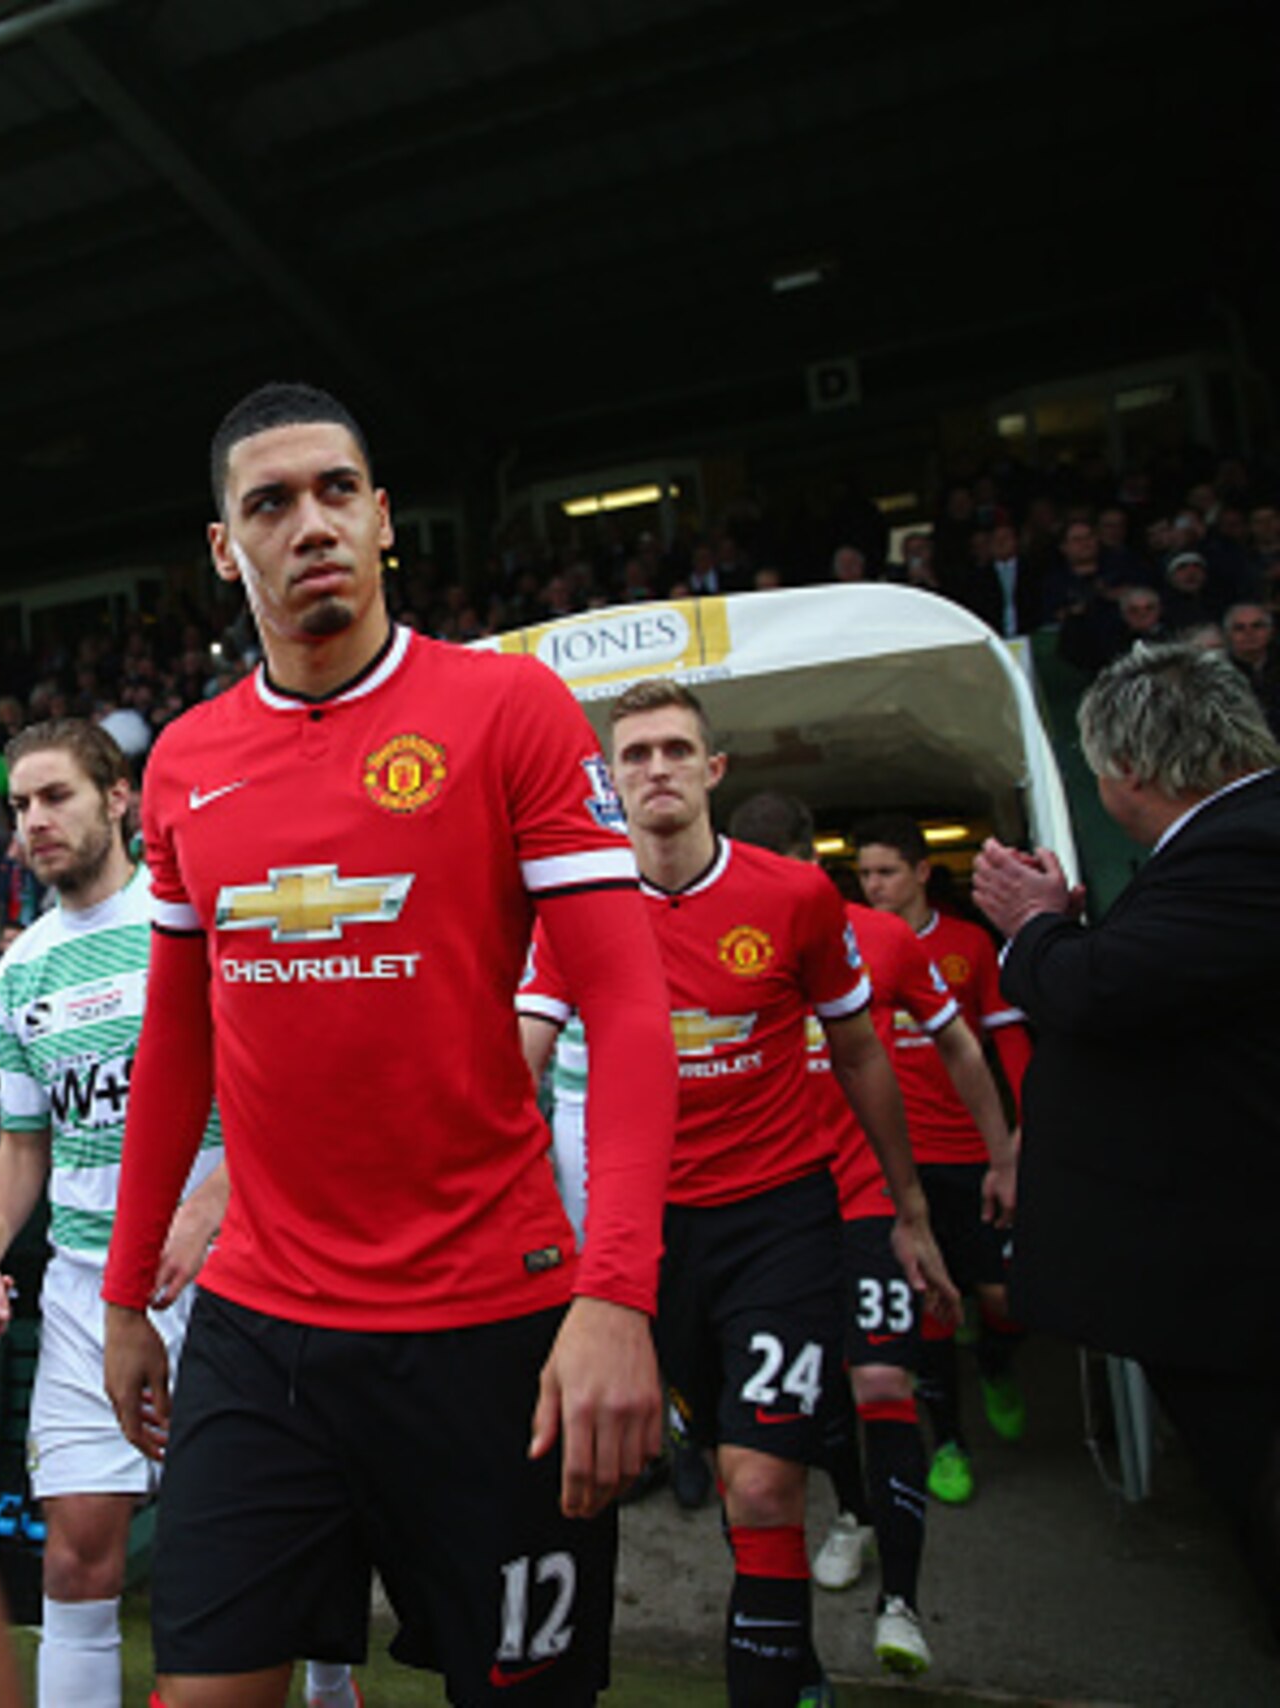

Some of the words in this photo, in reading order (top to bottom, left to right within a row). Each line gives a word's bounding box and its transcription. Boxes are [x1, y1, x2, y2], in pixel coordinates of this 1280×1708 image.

[549, 614, 677, 668] JONES
[221, 951, 422, 984] CHEVROLET
[856, 1277, 915, 1333] 33
[740, 1332, 824, 1416] 24
[495, 1551, 577, 1661] 12
